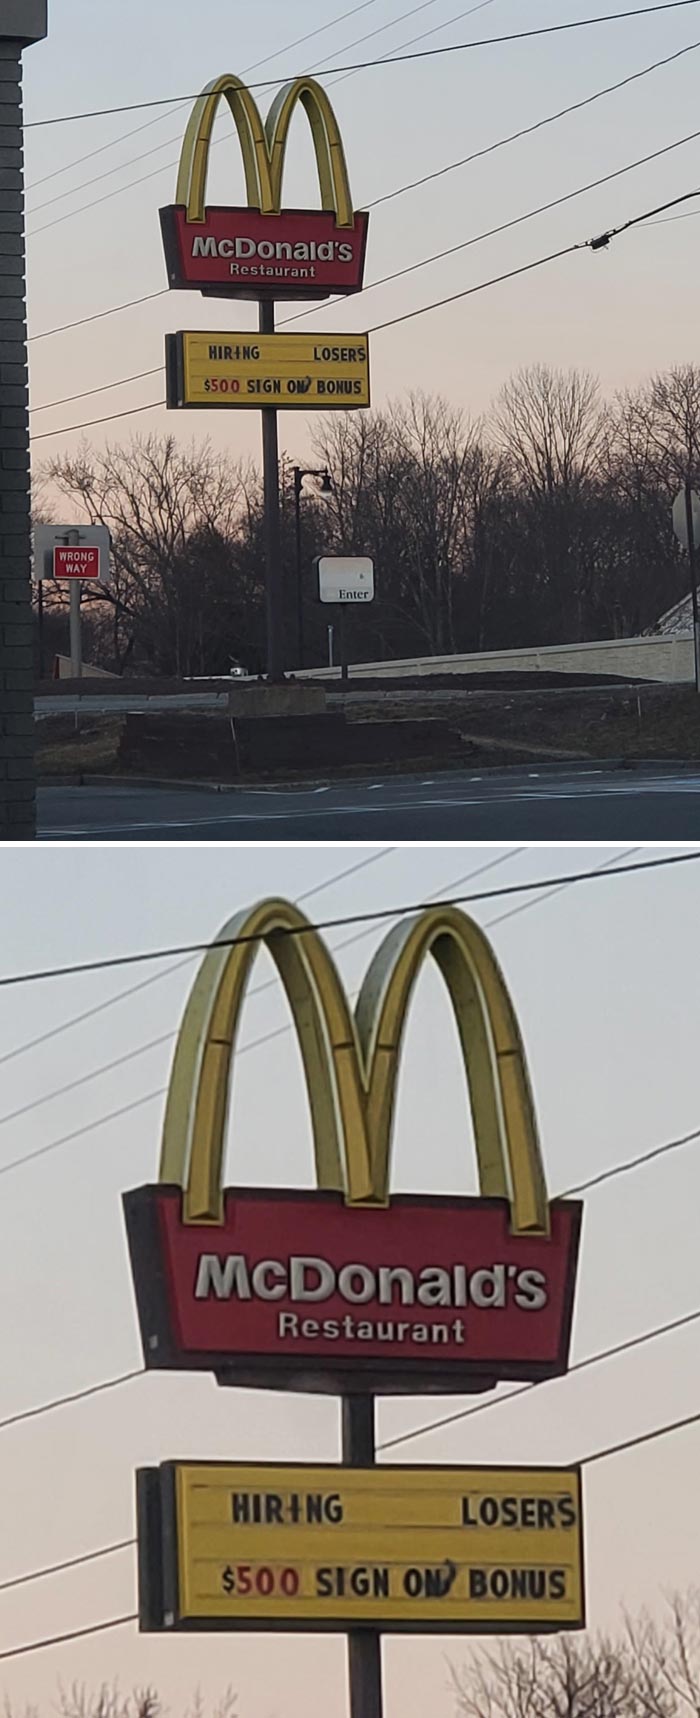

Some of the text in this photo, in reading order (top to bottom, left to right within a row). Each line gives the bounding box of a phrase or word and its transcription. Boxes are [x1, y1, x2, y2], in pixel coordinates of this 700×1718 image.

[191, 236, 353, 262] McDonald's
[230, 263, 316, 278] Restaurant
[208, 345, 366, 362] HIRING LOSERS
[203, 378, 240, 393] $500
[247, 379, 281, 394] SIGN
[316, 380, 362, 395] BONUS
[59, 552, 94, 561] WRONG
[65, 564, 87, 573] WAY
[339, 589, 369, 599] Enter
[194, 1253, 548, 1310] McDonald's
[277, 1312, 466, 1344] Restaurant
[231, 1493, 577, 1529] HIRING LOSERS
[221, 1565, 300, 1596] $500
[315, 1566, 390, 1598] SIGN
[468, 1568, 567, 1601] BONUS
